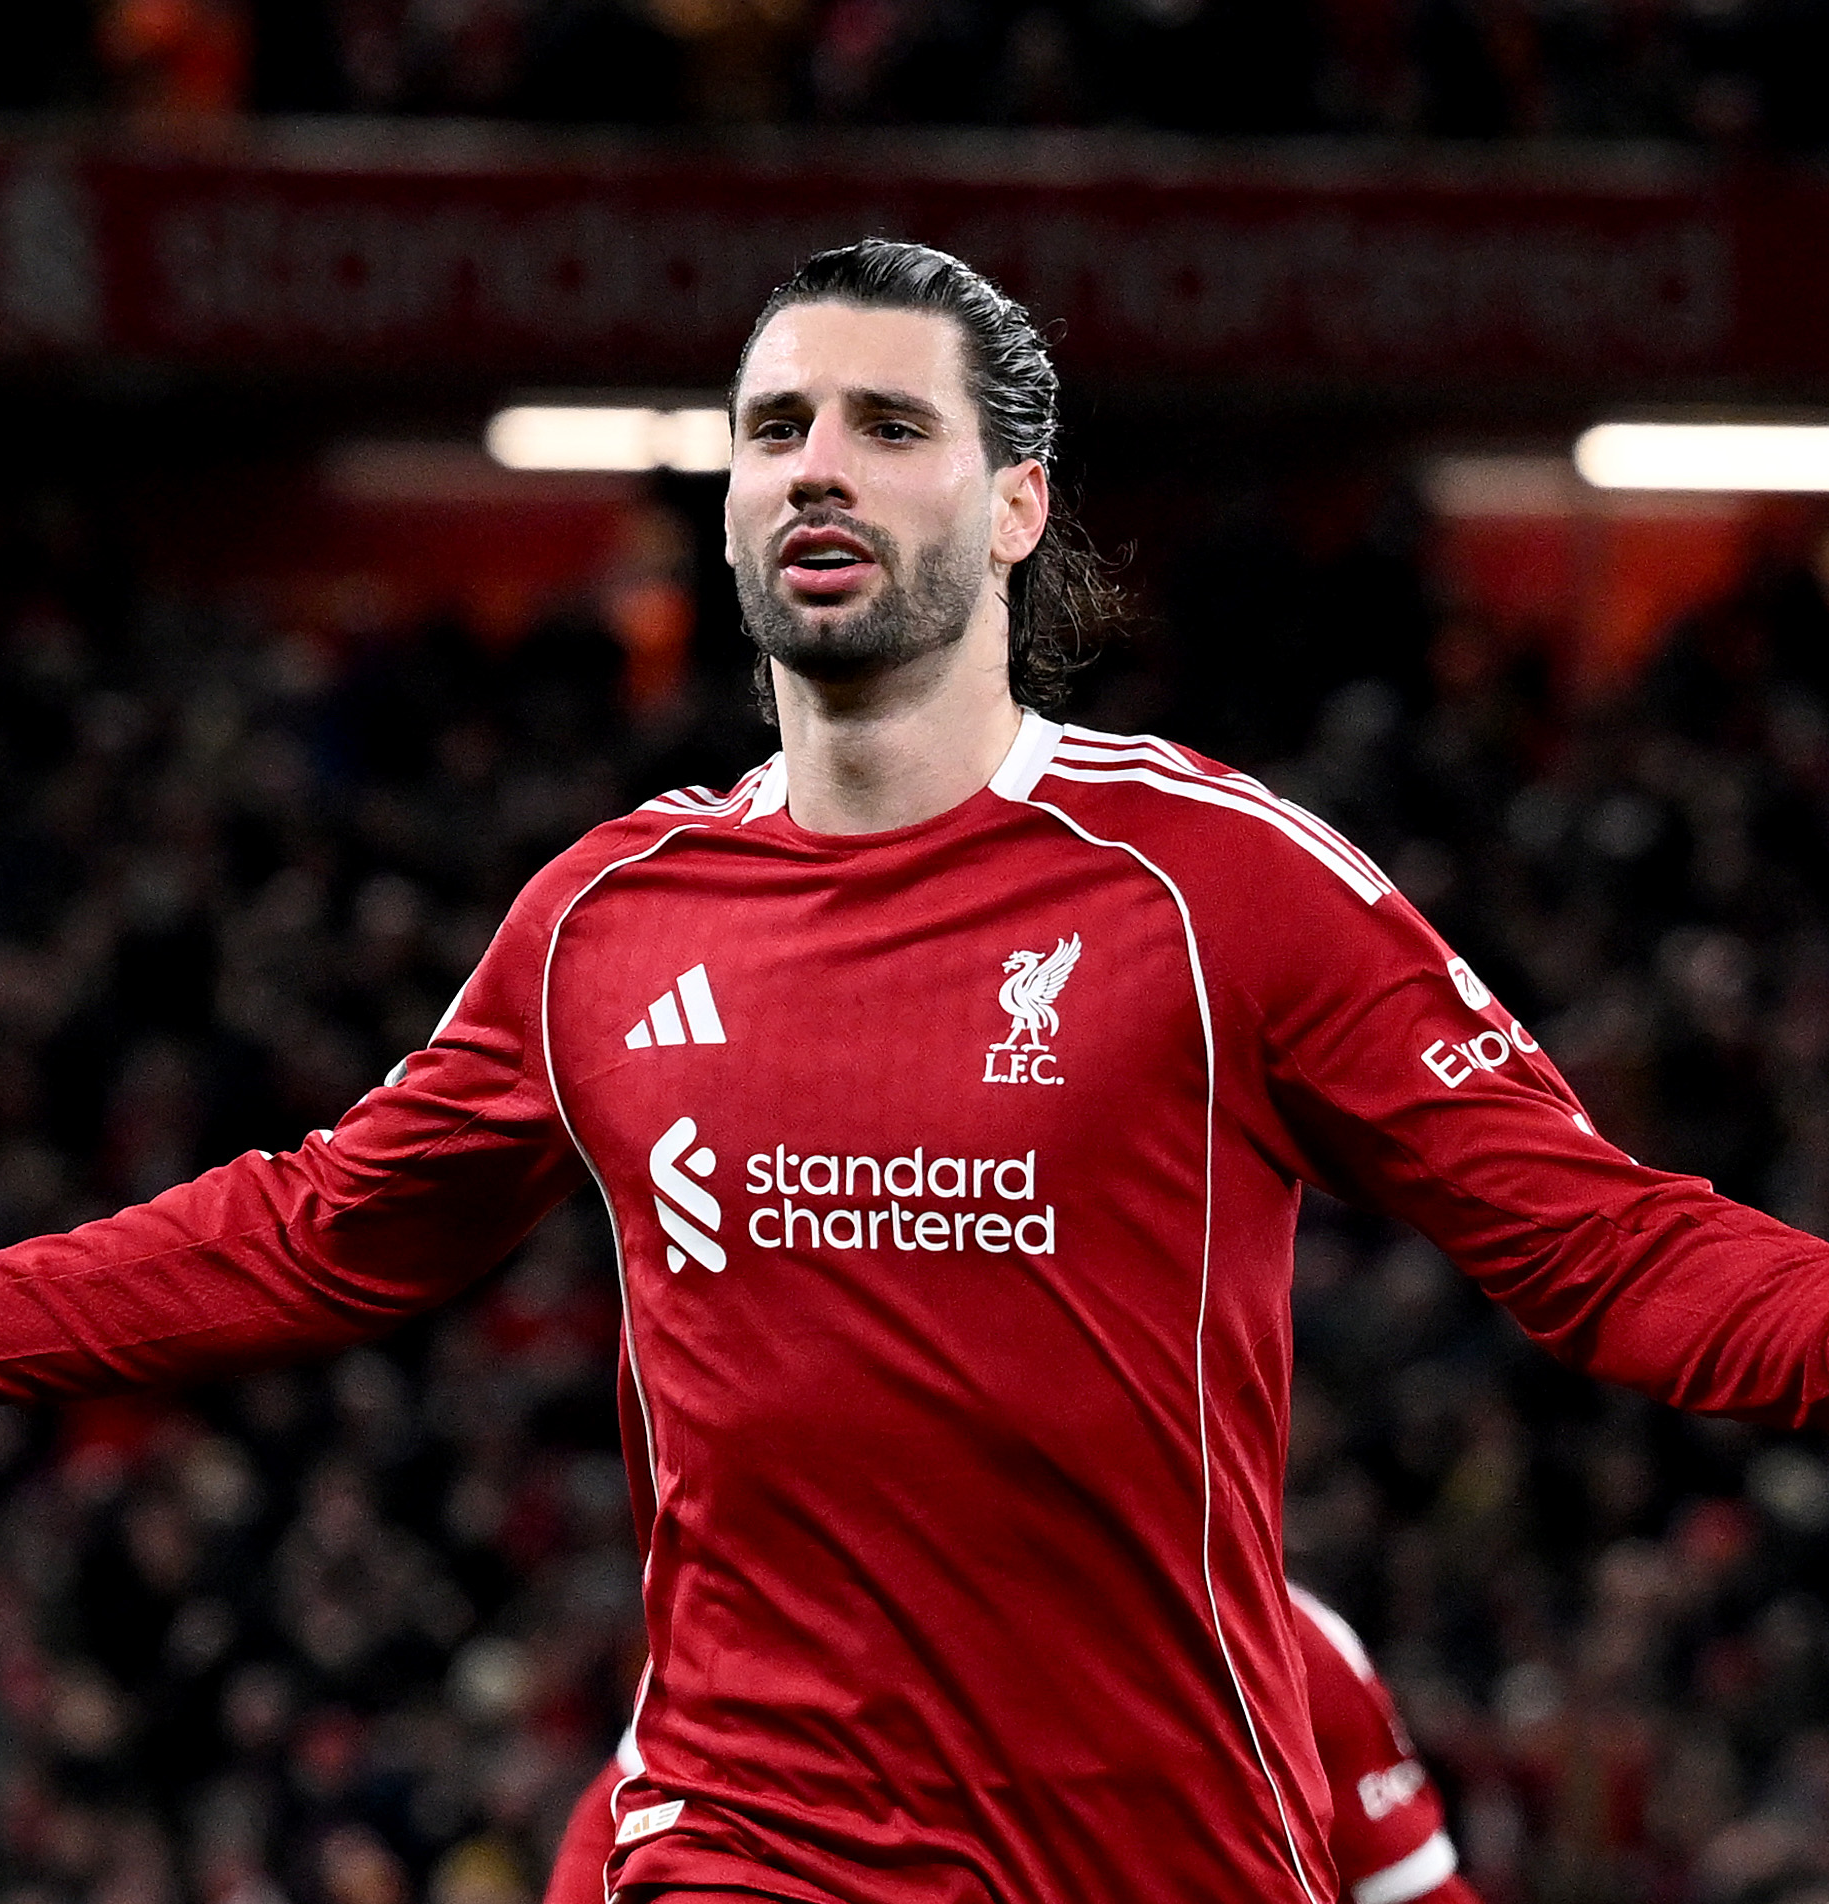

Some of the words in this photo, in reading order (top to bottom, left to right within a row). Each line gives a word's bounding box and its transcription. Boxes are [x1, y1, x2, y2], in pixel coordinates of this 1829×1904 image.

[982, 1053, 1065, 1085] L.F.C.
[746, 1143, 1035, 1200] standard
[748, 1198, 1055, 1255] chartered
